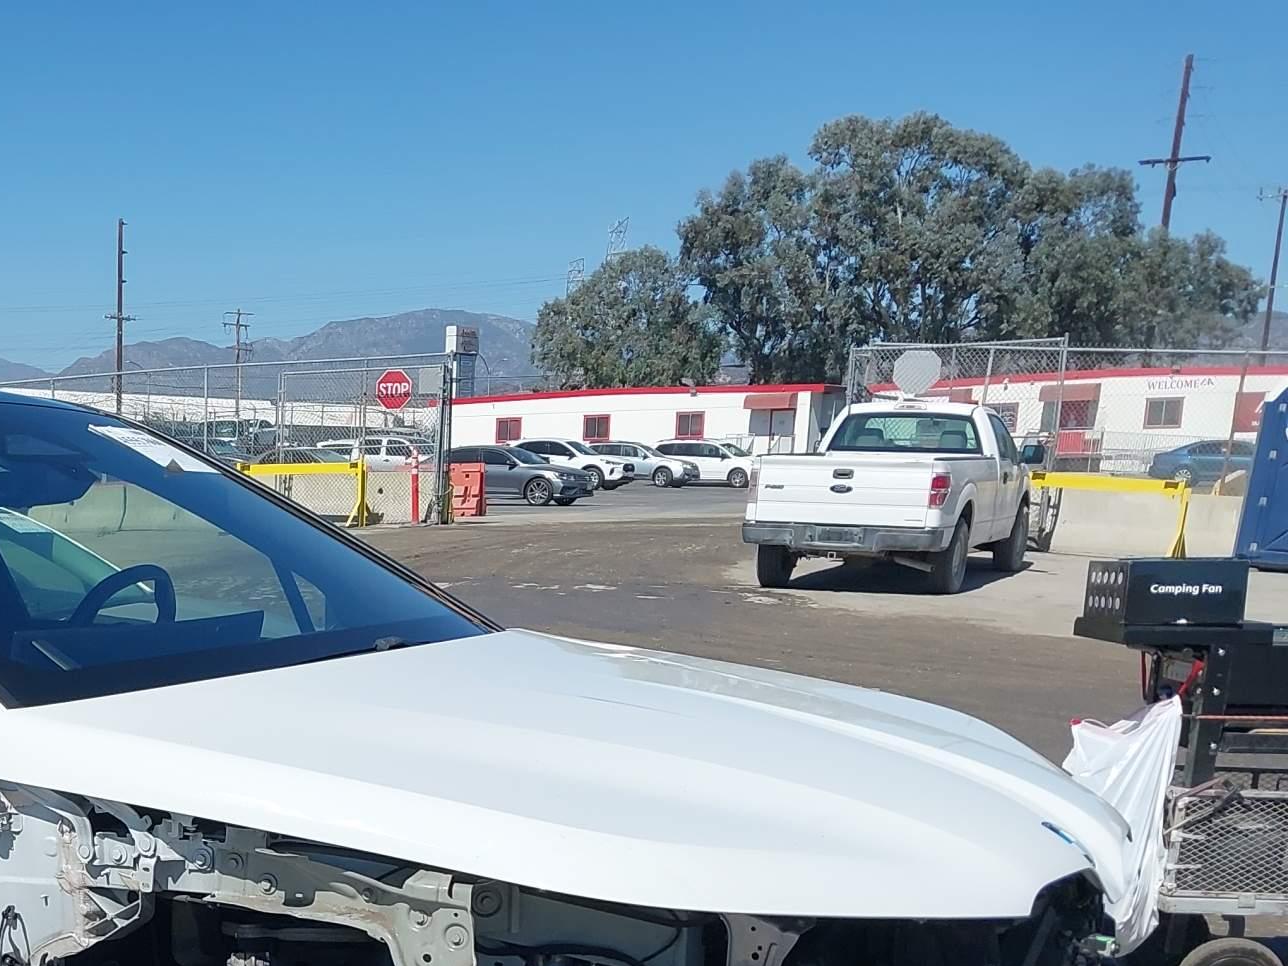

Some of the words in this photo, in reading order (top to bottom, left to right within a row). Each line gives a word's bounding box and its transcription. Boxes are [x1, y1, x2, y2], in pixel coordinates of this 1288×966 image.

[379, 382, 409, 398] STOP
[1147, 379, 1200, 391] WELCOME
[1150, 583, 1200, 596] Camping
[1202, 583, 1223, 593] Fan
